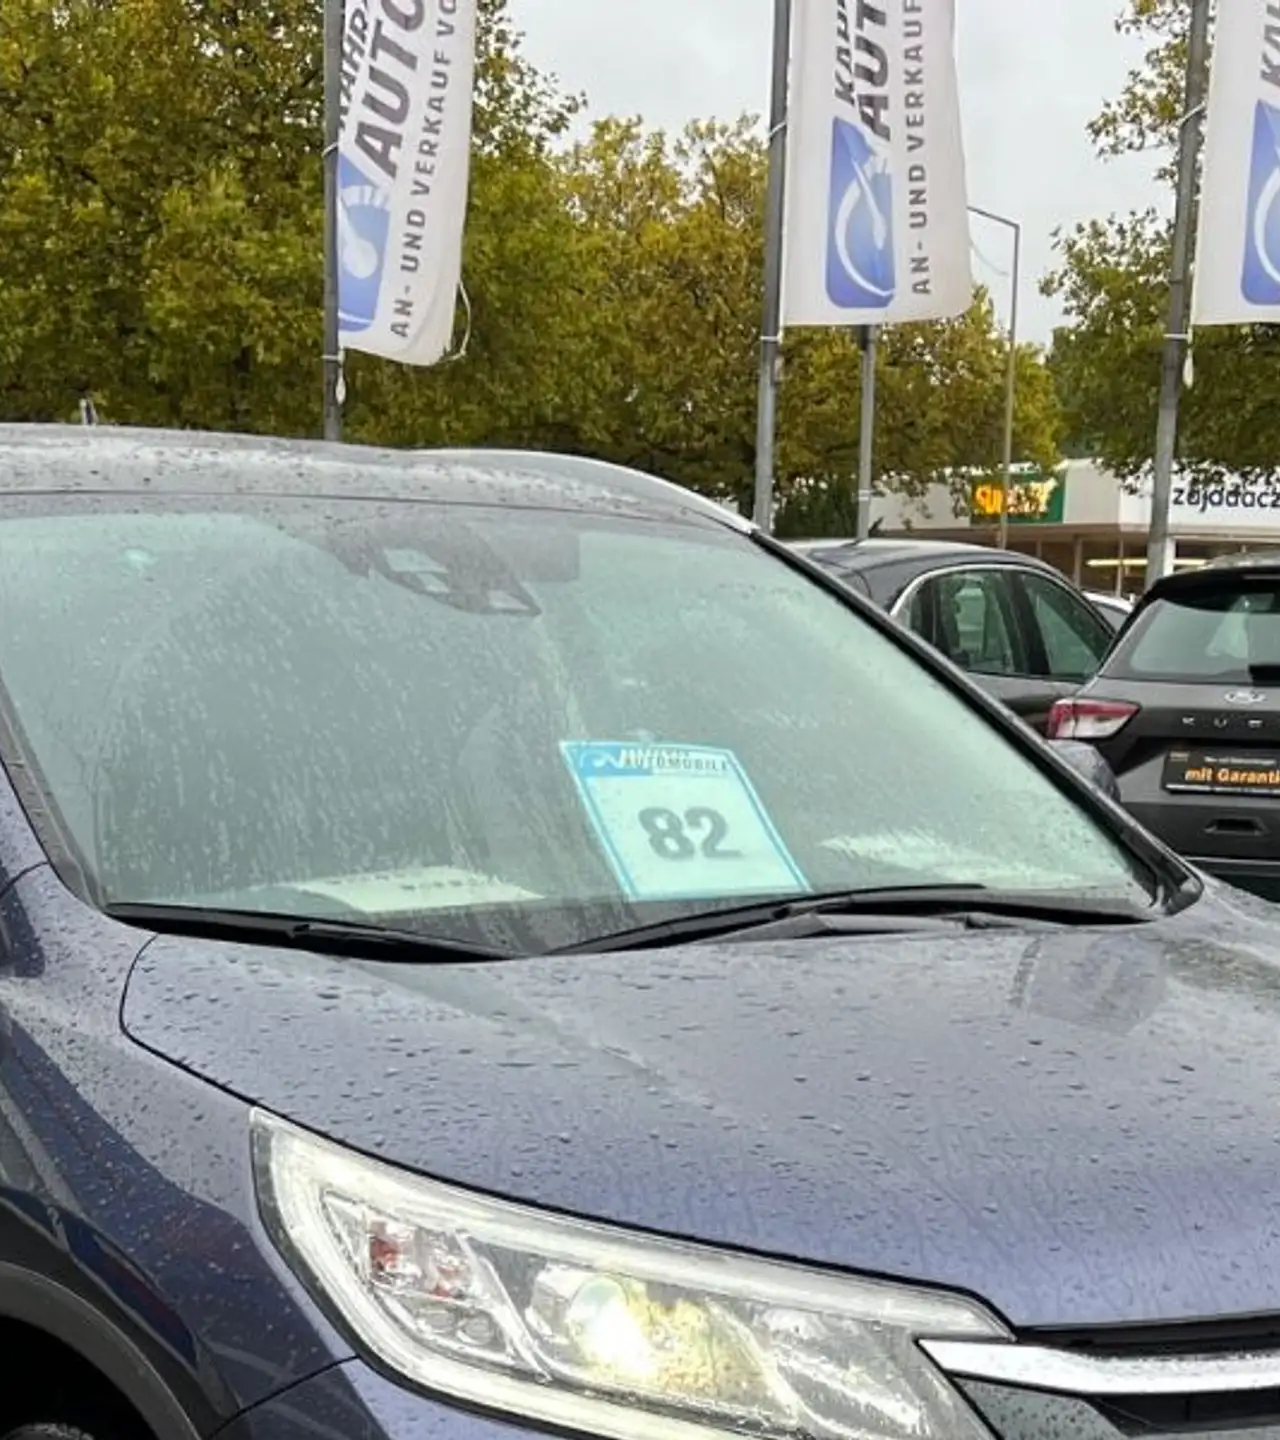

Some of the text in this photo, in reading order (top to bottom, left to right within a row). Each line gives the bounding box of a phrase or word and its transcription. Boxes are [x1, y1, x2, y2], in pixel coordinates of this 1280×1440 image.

[903, 0, 925, 153] VERKAUF
[410, 49, 451, 198] VERKAUF
[908, 163, 928, 230] UND
[400, 208, 427, 274] UND
[1184, 767, 1213, 781] mit
[637, 806, 744, 862] 82
